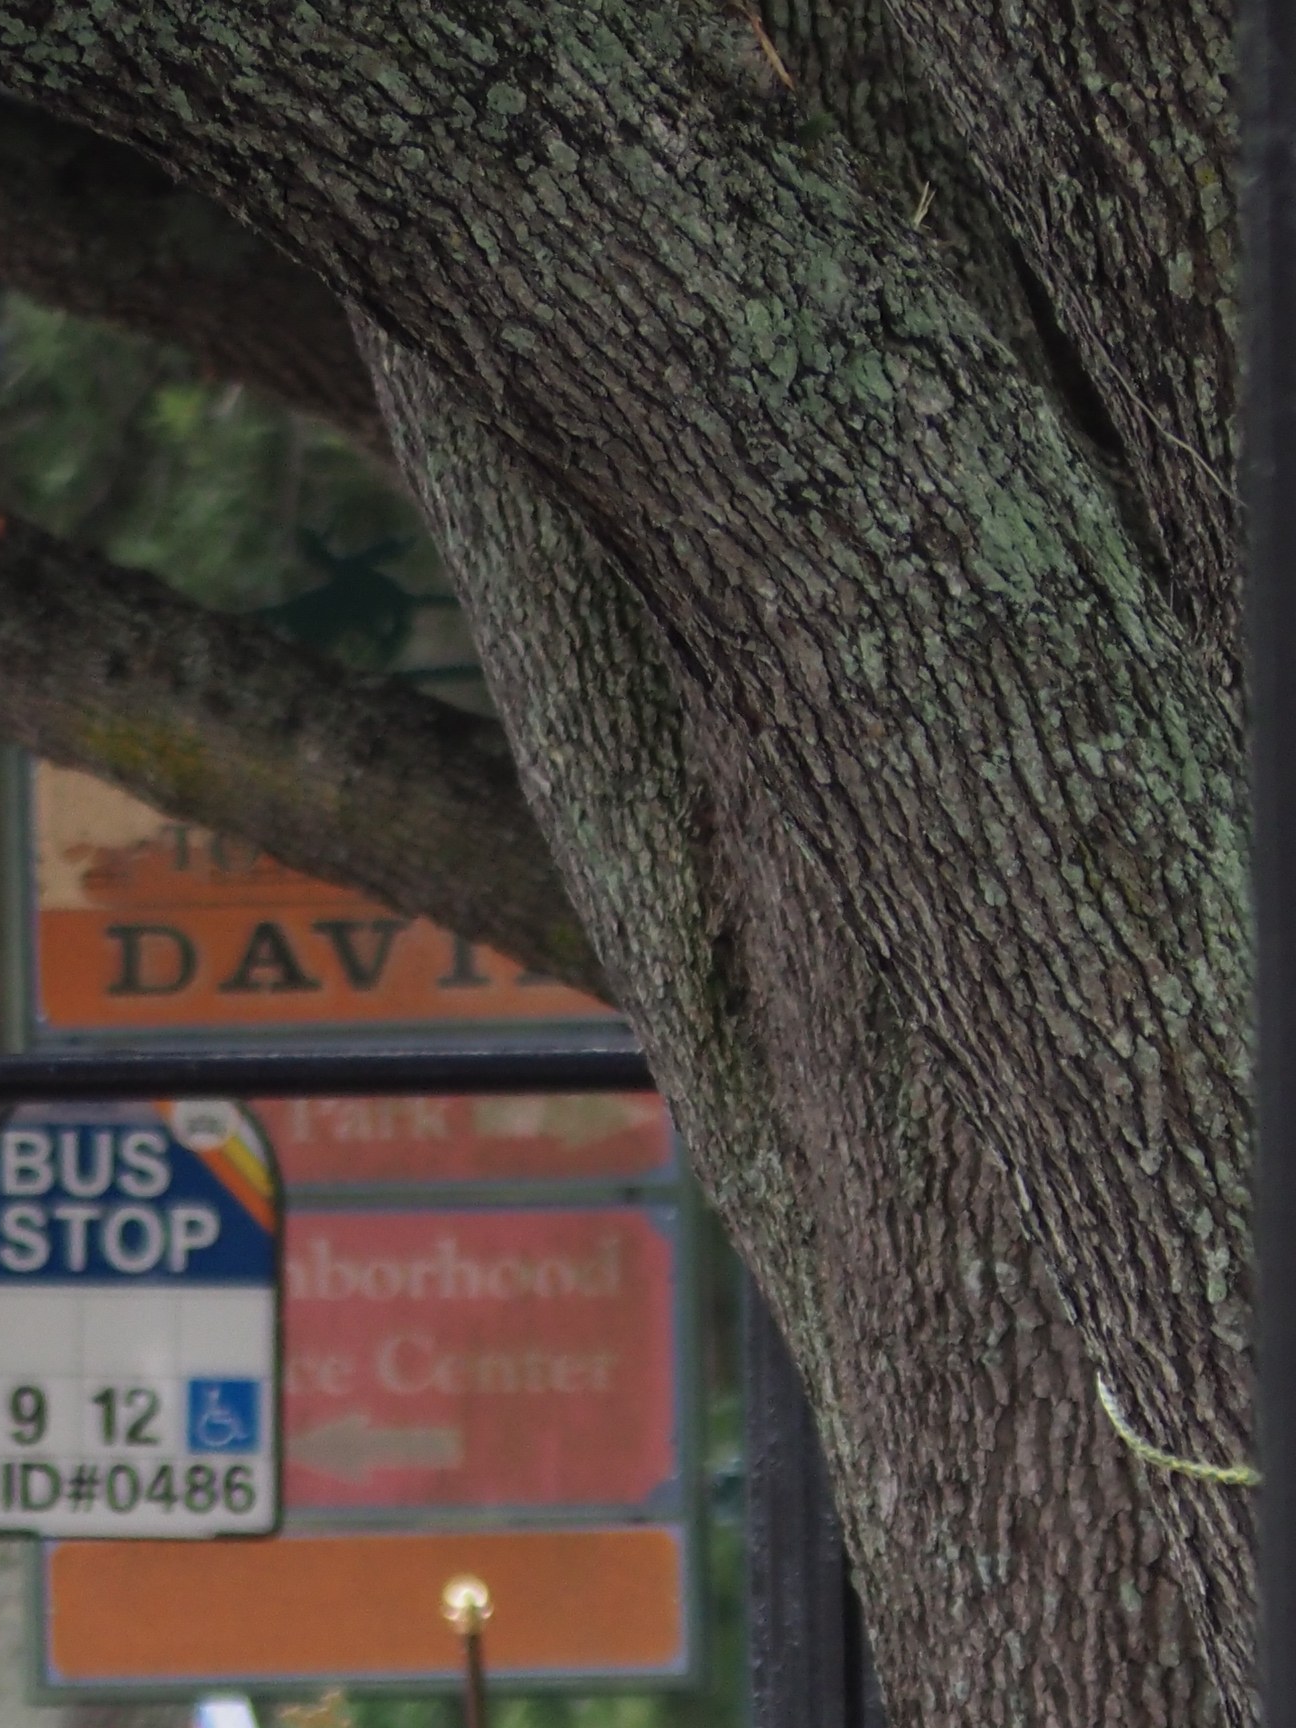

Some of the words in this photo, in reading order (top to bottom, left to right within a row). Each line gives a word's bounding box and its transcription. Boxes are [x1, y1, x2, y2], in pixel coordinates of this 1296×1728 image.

[106, 920, 570, 996] DAVI
[376, 1332, 617, 1396] Center
[9, 1385, 48, 1446] 9
[92, 1387, 160, 1447] 12
[2, 1462, 257, 1514] ID#0486
